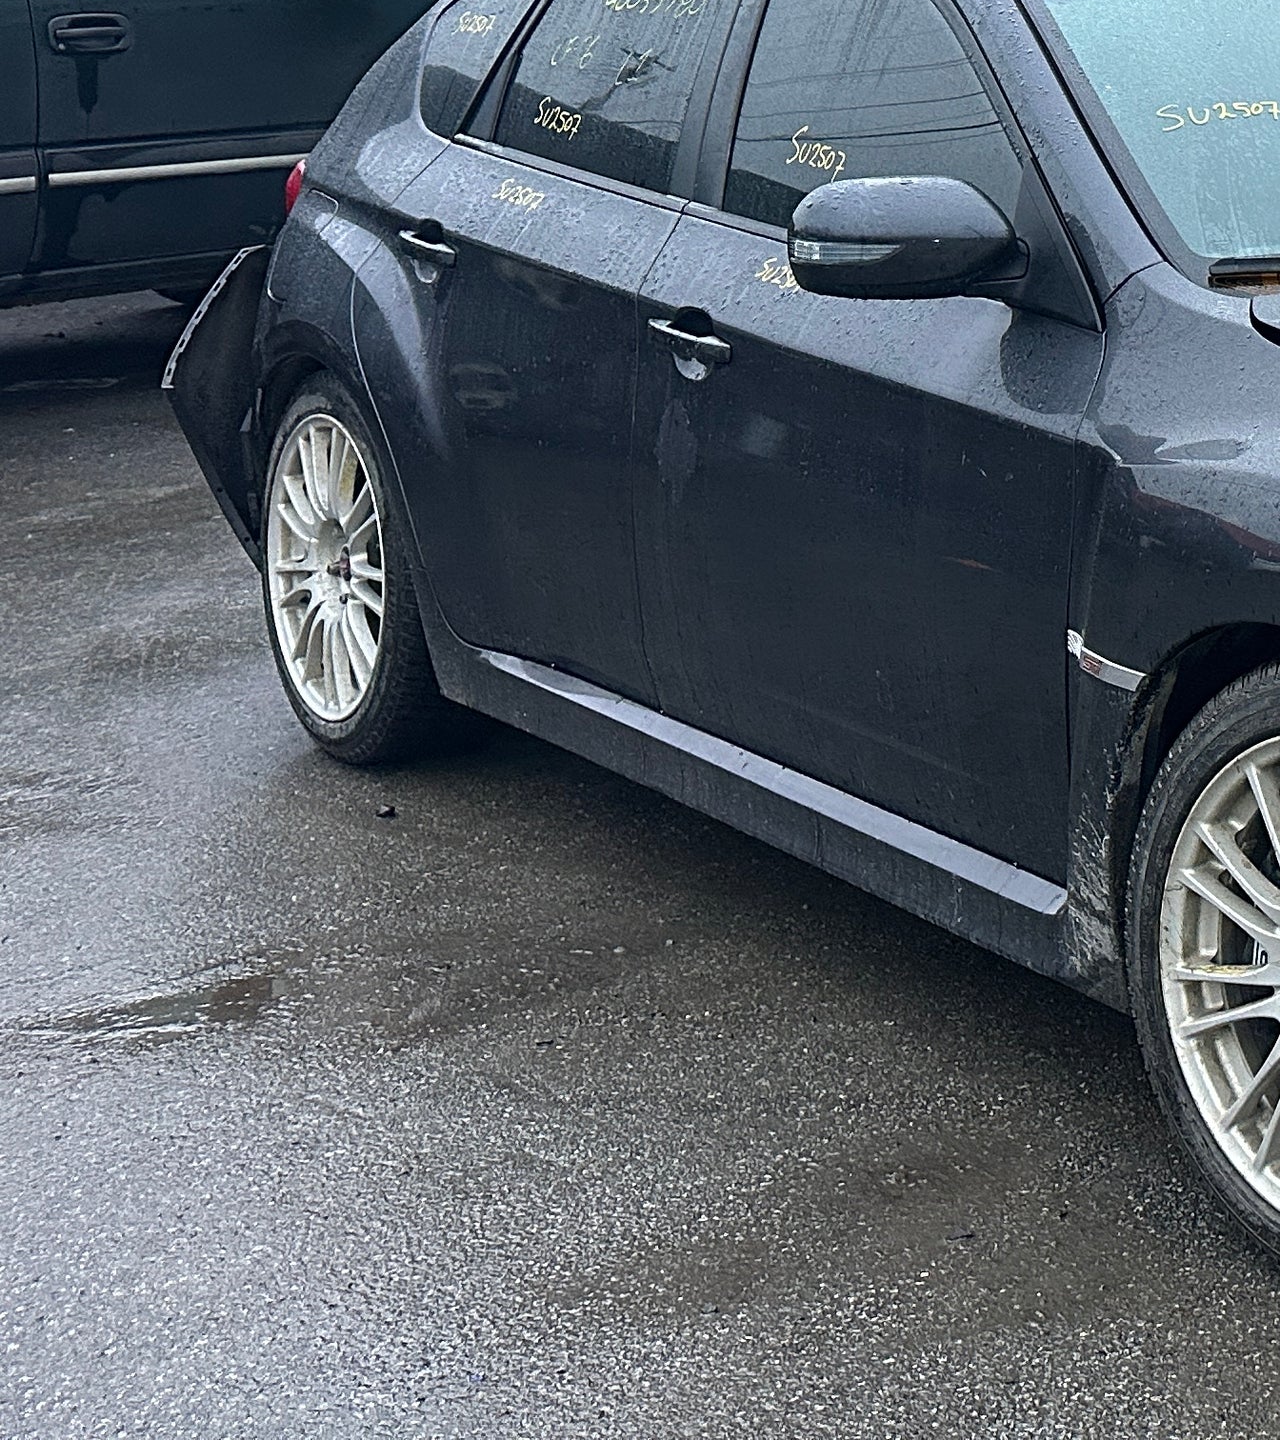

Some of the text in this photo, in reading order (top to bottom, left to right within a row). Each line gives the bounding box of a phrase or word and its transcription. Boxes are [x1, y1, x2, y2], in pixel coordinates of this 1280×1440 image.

[533, 96, 582, 141] SU2507
[1155, 100, 1280, 132] SU2507
[785, 125, 847, 184] SU2507
[490, 177, 546, 215] SU2507
